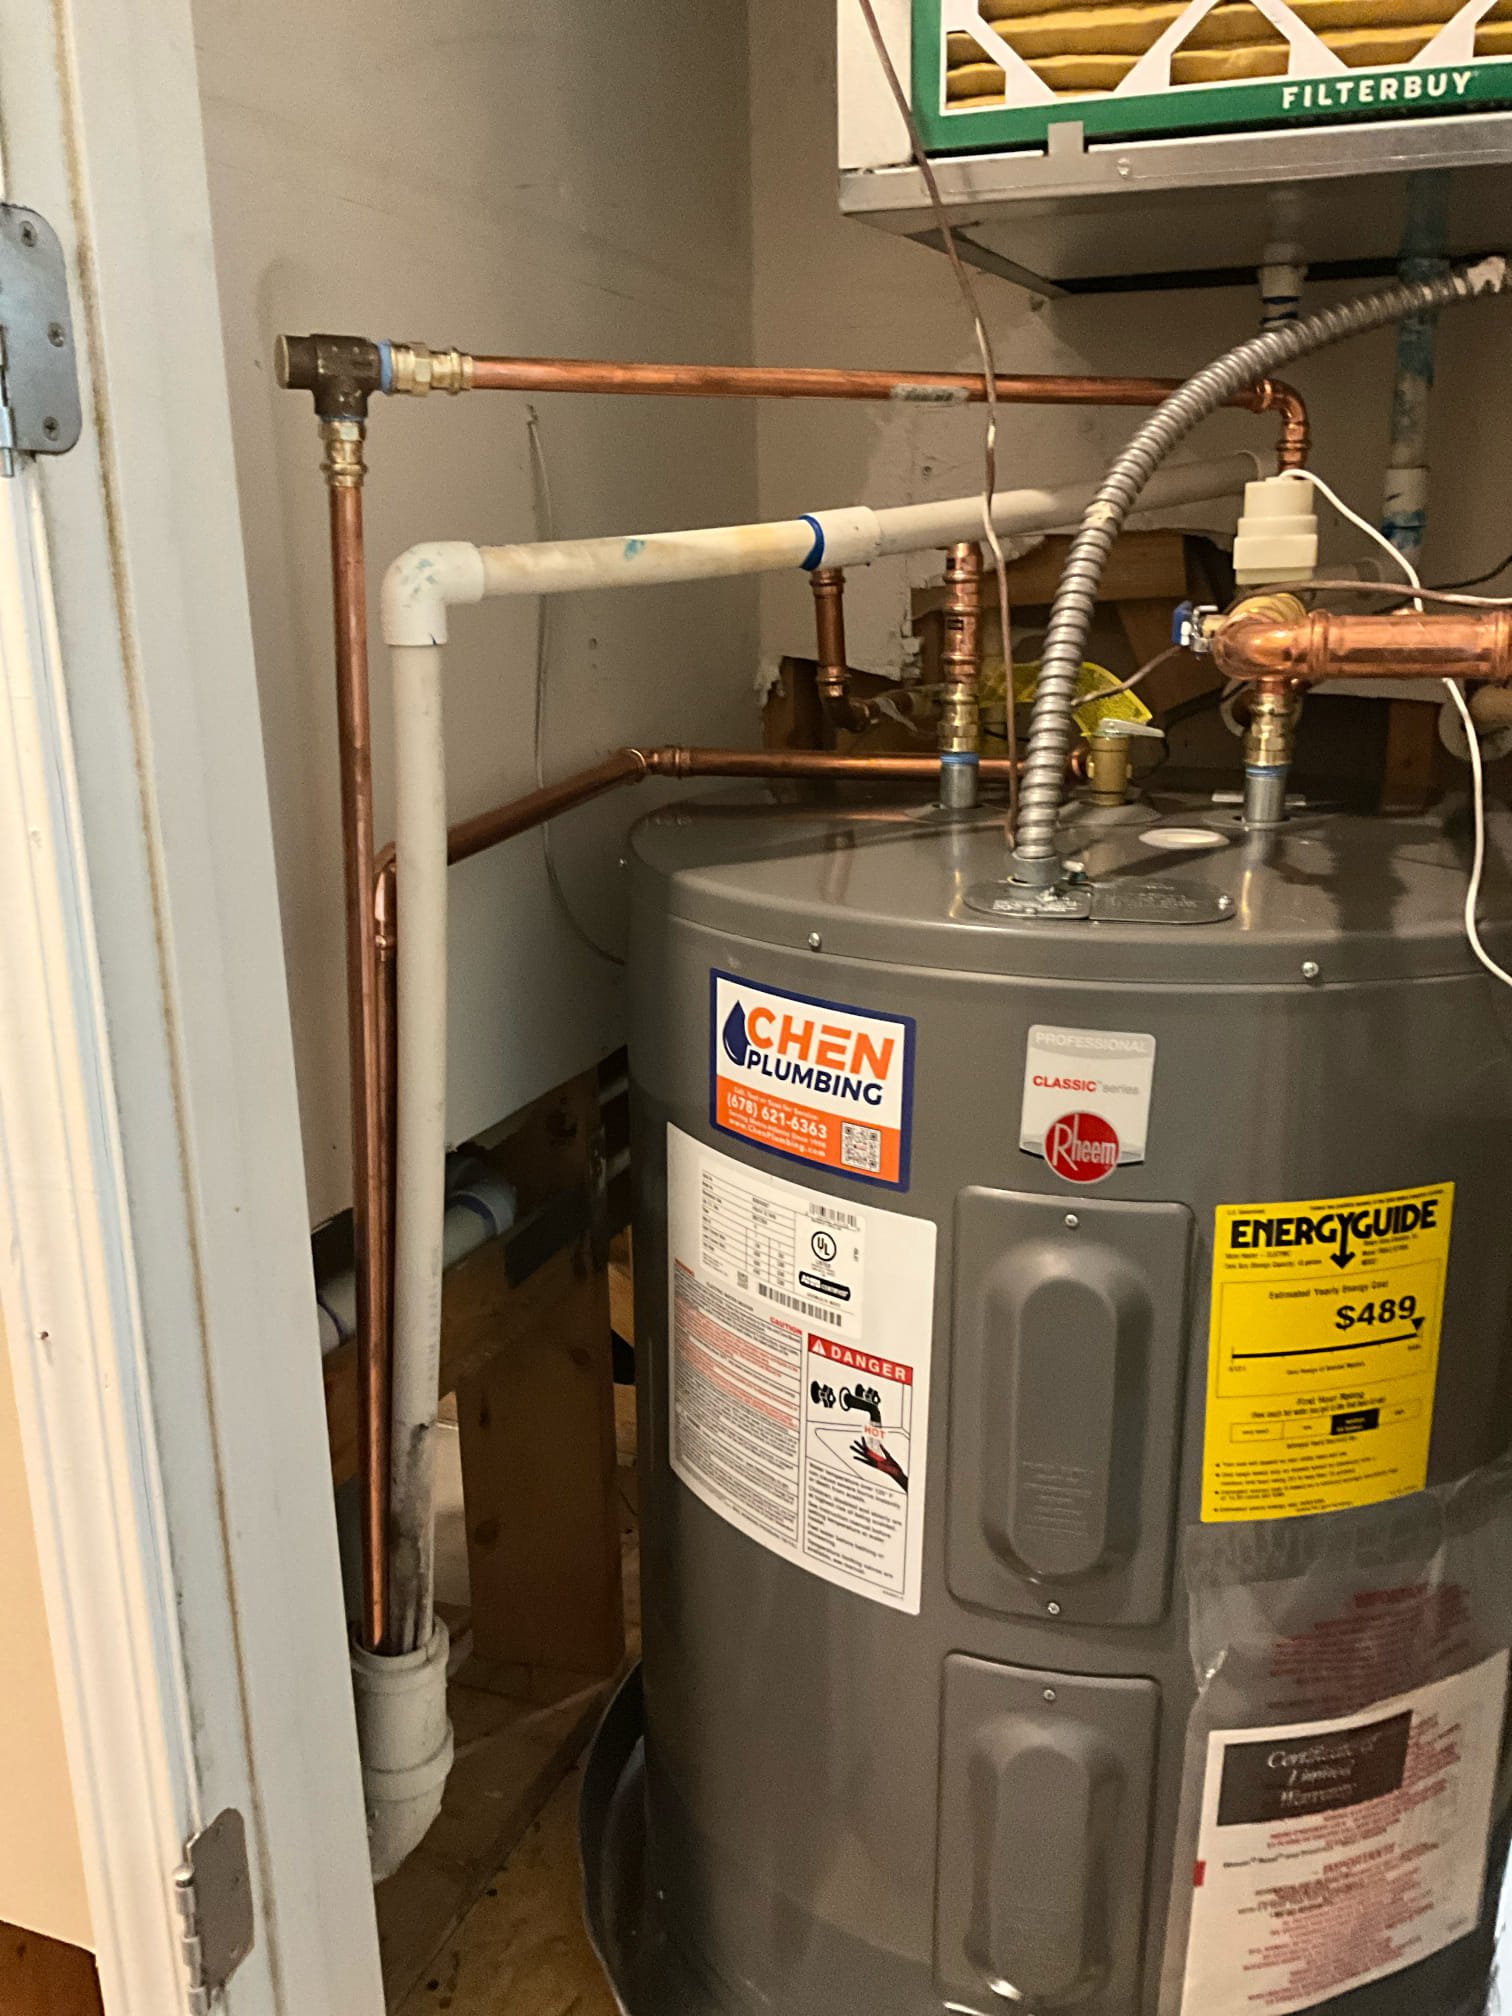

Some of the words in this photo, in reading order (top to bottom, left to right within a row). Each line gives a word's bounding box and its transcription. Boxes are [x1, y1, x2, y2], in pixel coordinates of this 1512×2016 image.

[1283, 71, 1472, 109] FILTERBUY
[747, 1007, 894, 1080] CHEN
[1035, 1032, 1148, 1052] PROFESSIONAL
[747, 1050, 882, 1105] PLUMBING
[1033, 1075, 1096, 1092] CLASSIC
[1102, 1083, 1139, 1095] series
[728, 1092, 757, 1118] (678)
[761, 1107, 827, 1139] 621-6363
[1052, 1114, 1116, 1171] Rheem
[1231, 1199, 1438, 1249] ENERGYGUIDE
[770, 1316, 803, 1335] CAUTION
[1336, 1295, 1416, 1331] $489
[831, 1345, 906, 1380] DANGER
[864, 1425, 886, 1438] HOT
